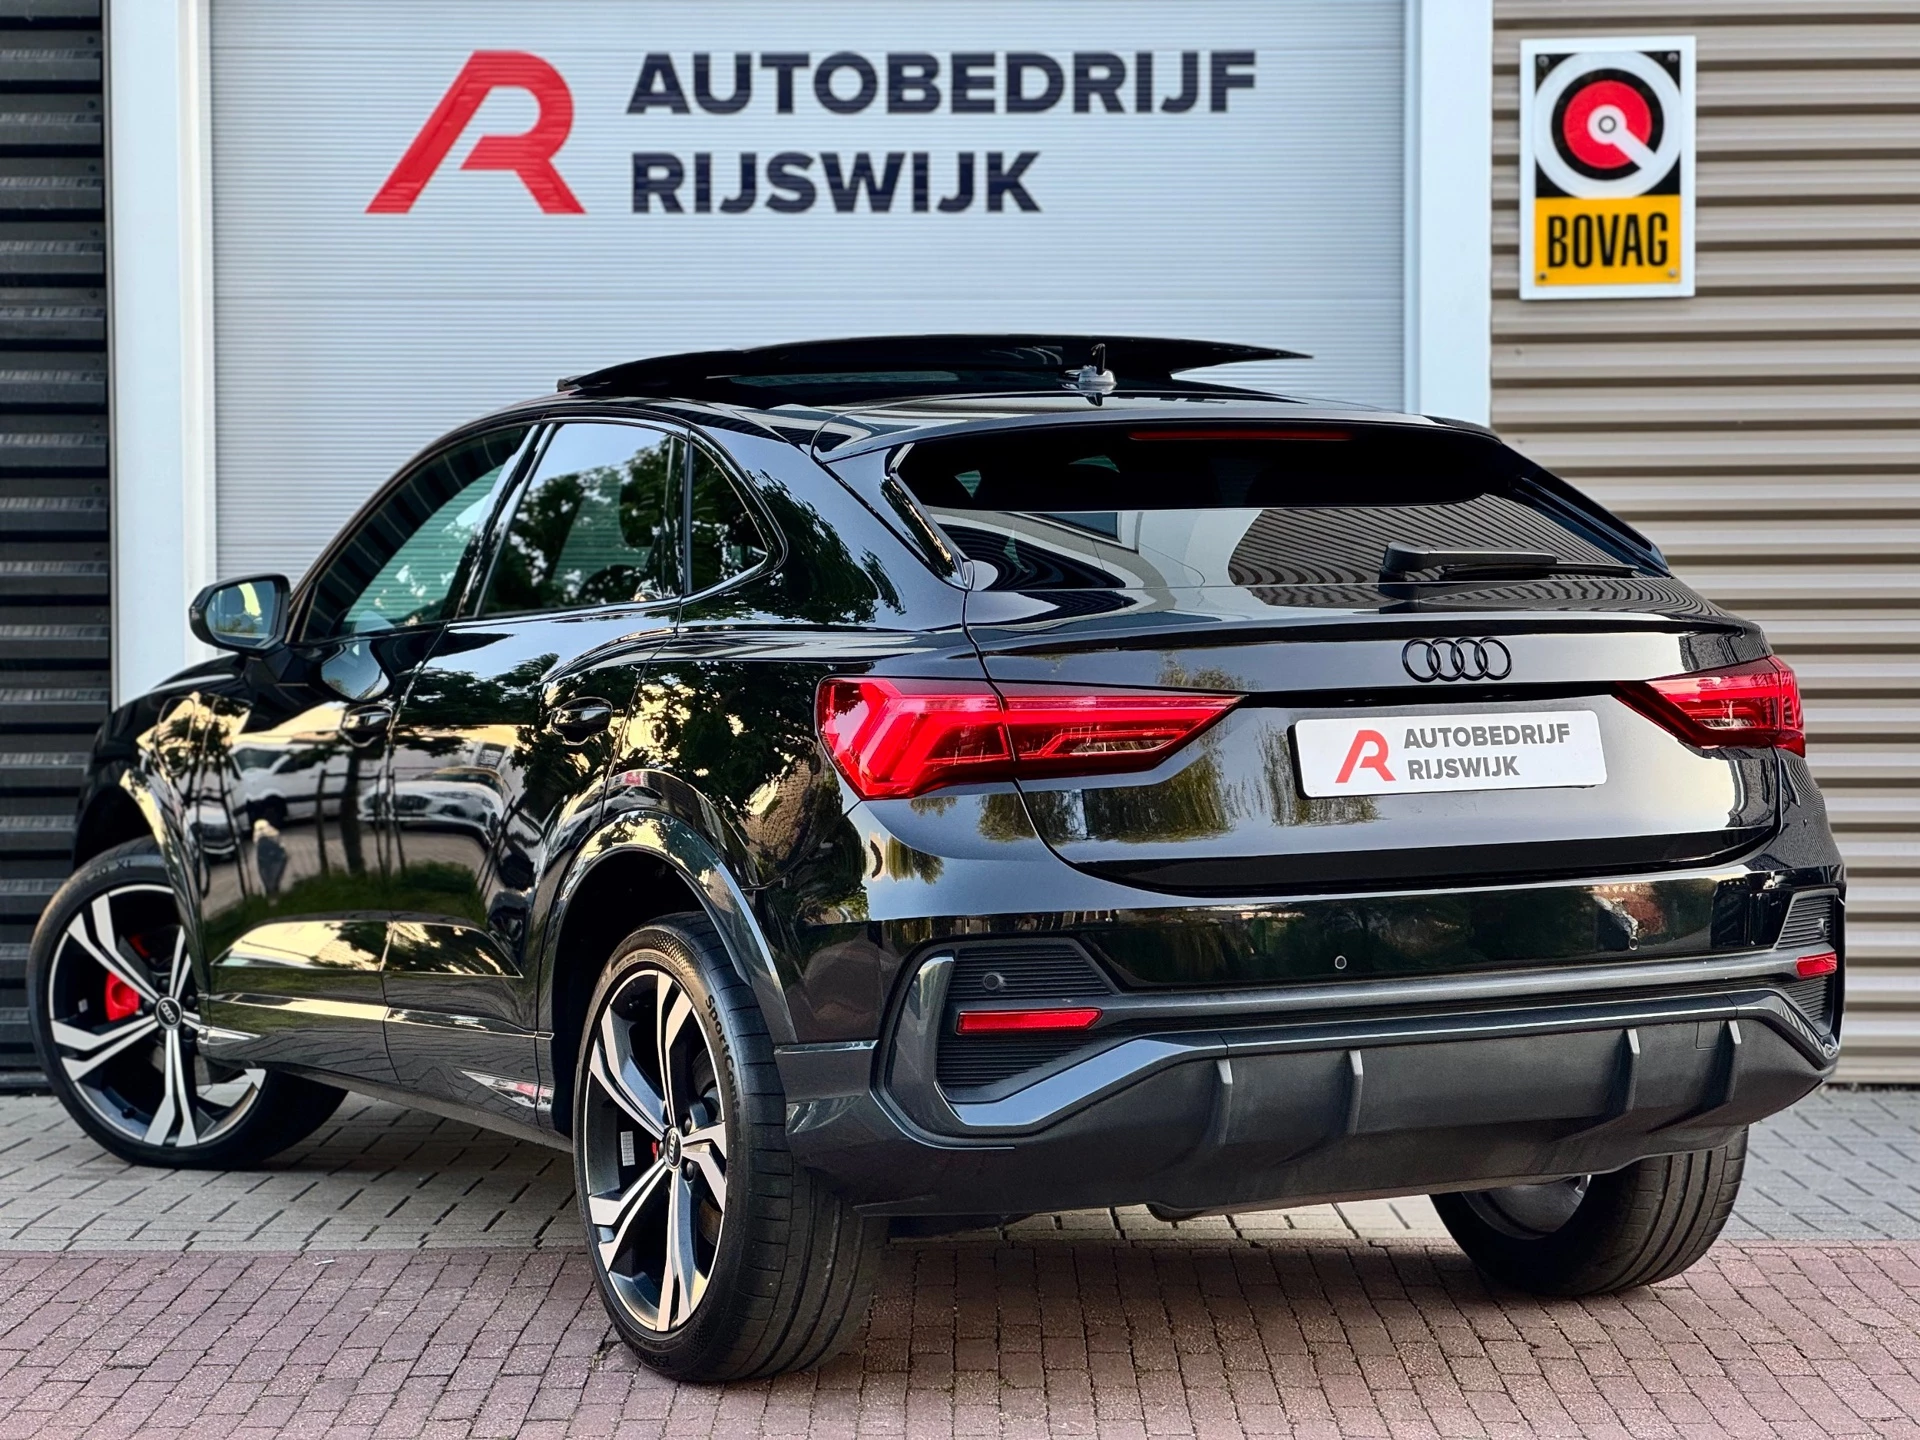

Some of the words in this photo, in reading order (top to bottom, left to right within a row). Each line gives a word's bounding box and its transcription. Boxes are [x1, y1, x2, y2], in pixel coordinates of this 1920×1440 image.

[627, 51, 1256, 115] AUTOBEDRIJF
[633, 151, 1041, 214] RIJSWIJK
[1547, 212, 1668, 268] BOVAG
[1404, 723, 1571, 749] AUTOBEDRIJF
[1408, 755, 1521, 781] RIJSWIJK
